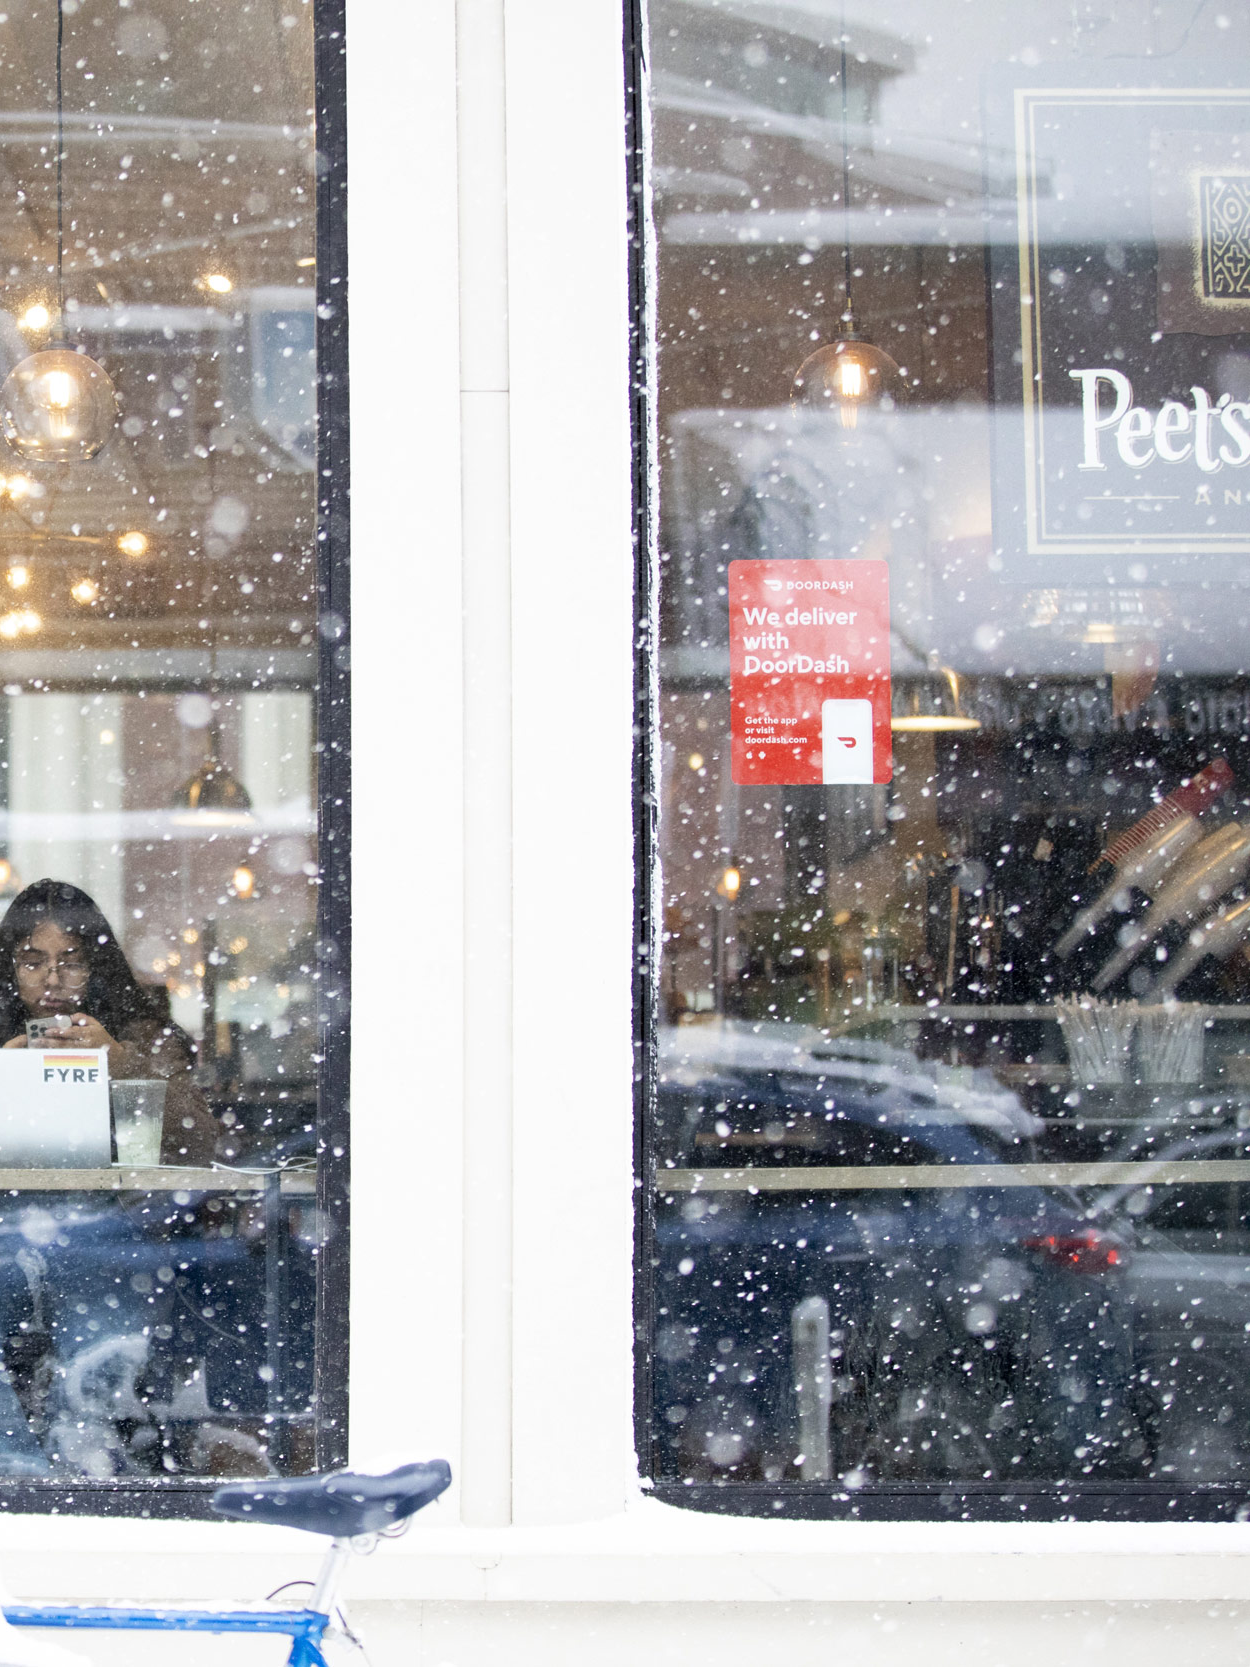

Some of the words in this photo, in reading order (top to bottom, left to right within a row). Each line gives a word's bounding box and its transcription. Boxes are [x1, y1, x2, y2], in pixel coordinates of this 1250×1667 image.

[1068, 368, 1250, 474] Peet's
[786, 581, 854, 590] DOORDASH
[742, 607, 780, 626] We
[785, 607, 858, 625] deliver
[742, 631, 789, 650] with
[744, 655, 850, 674] DoorDash
[744, 716, 762, 725] Get
[764, 716, 779, 725] the
[781, 718, 798, 726] app
[756, 726, 775, 734] visit
[744, 736, 808, 744] doordash.com
[43, 1068, 99, 1082] FYRE
